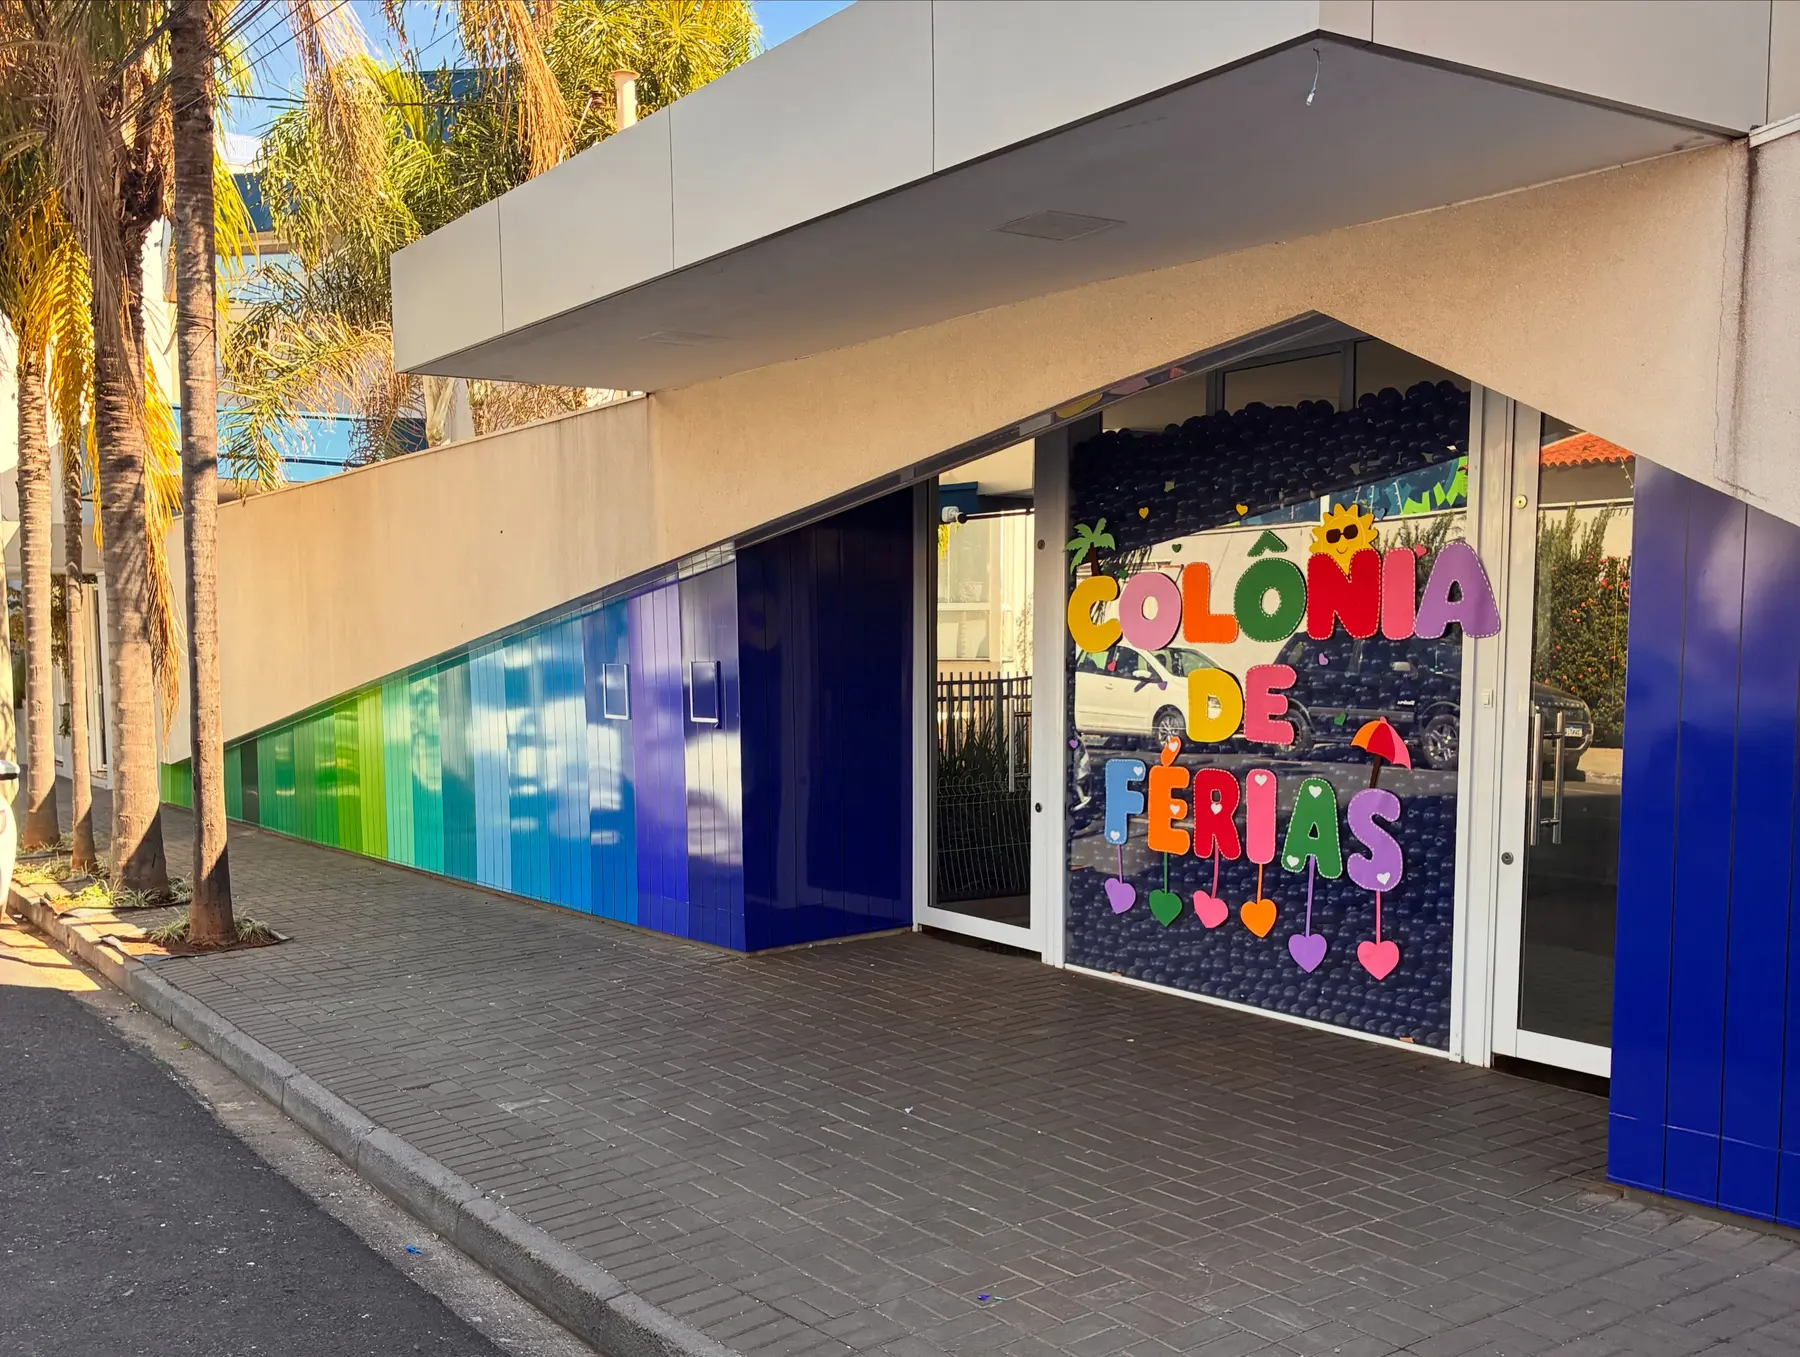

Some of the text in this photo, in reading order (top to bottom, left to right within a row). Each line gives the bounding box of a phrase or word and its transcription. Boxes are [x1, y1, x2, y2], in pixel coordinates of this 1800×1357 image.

[1067, 530, 1501, 653] COLÔNIA
[1187, 664, 1297, 744] DE
[1105, 737, 1403, 891] FÉRIAS
